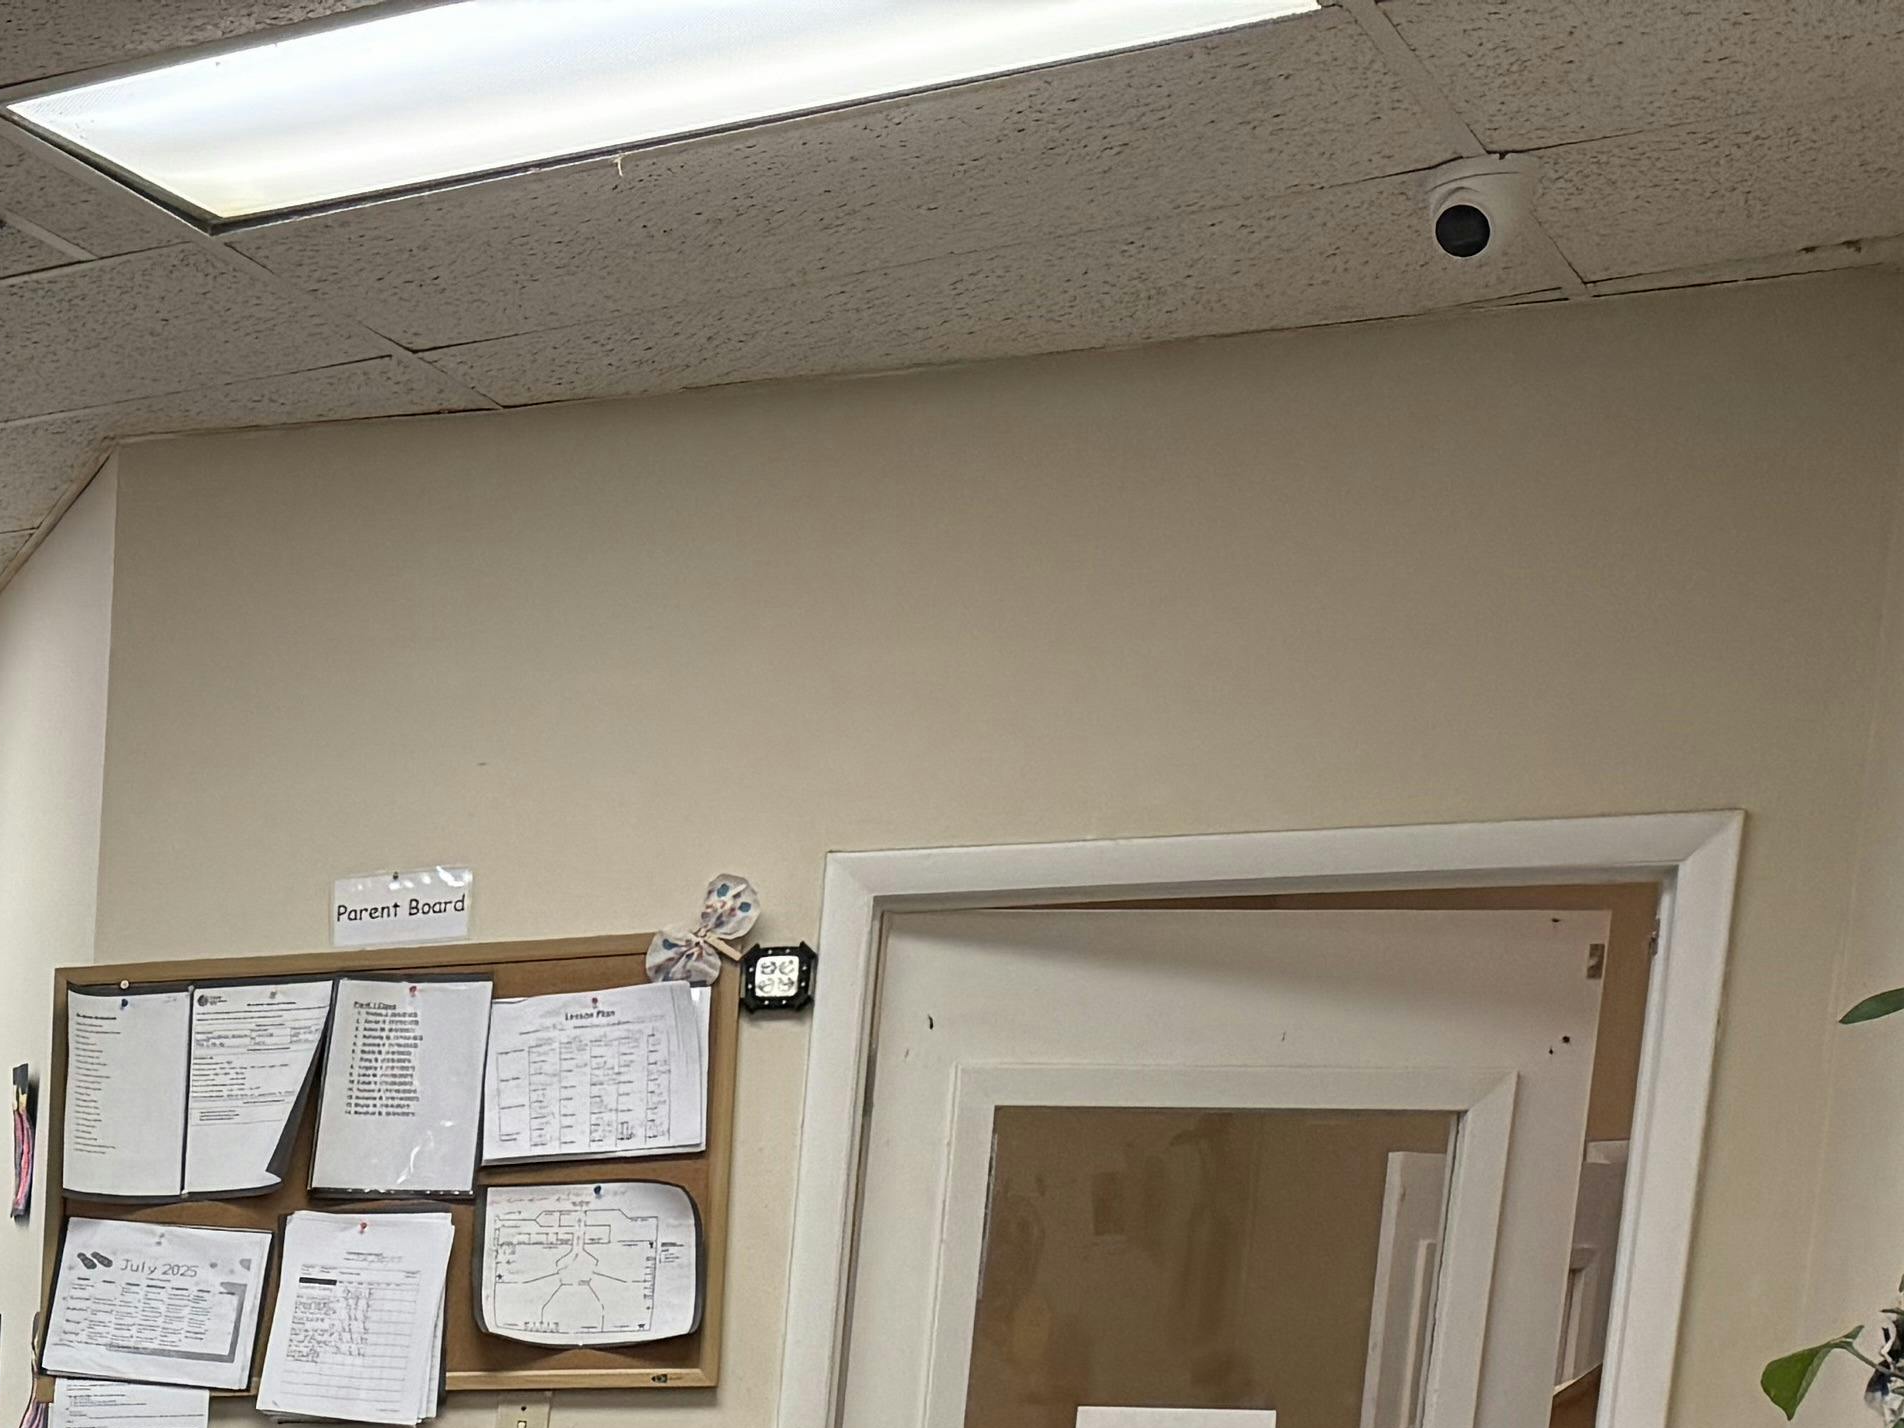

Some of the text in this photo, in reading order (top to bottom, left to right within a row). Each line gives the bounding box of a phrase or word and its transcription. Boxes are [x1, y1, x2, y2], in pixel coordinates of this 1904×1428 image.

[337, 893, 466, 922] Parent Board
[565, 1009, 615, 1021] Lesson Plan
[120, 1258, 199, 1278] July 2025
